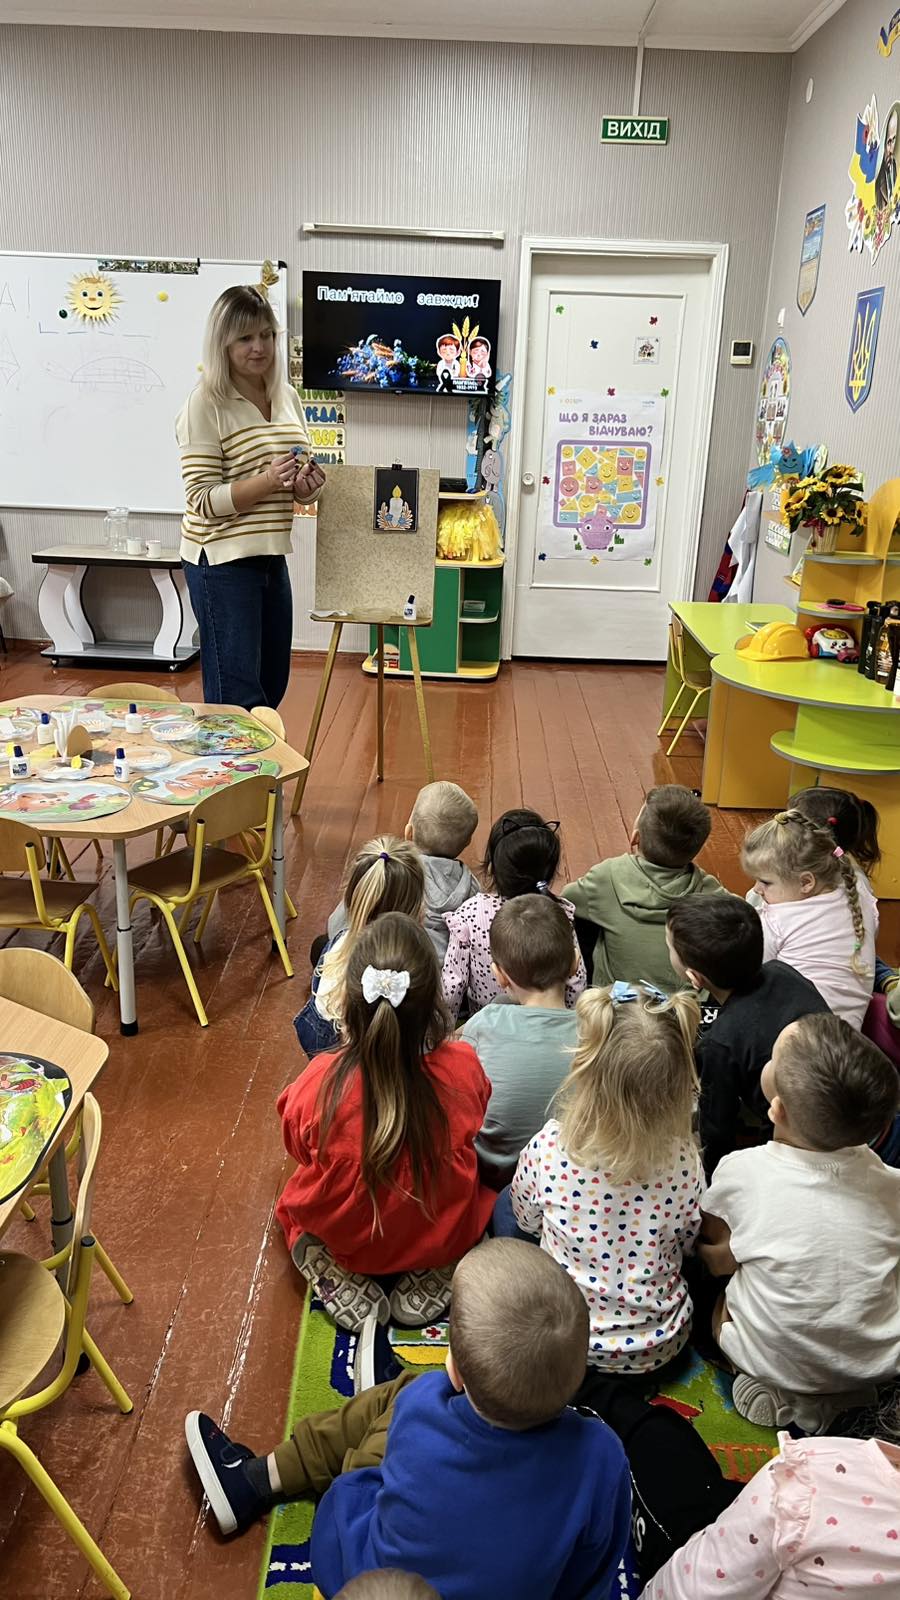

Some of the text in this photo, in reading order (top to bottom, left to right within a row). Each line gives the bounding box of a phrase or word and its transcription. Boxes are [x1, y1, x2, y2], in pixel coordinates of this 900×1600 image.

[607, 121, 661, 139] ВИХІД
[317, 285, 480, 309] Пам'ятаймо завжди!
[303, 406, 337, 422] РЕДА
[559, 412, 627, 424] ЩО Я ЗАРАЗ
[589, 425, 654, 437] ВІДЧУВАЮ?
